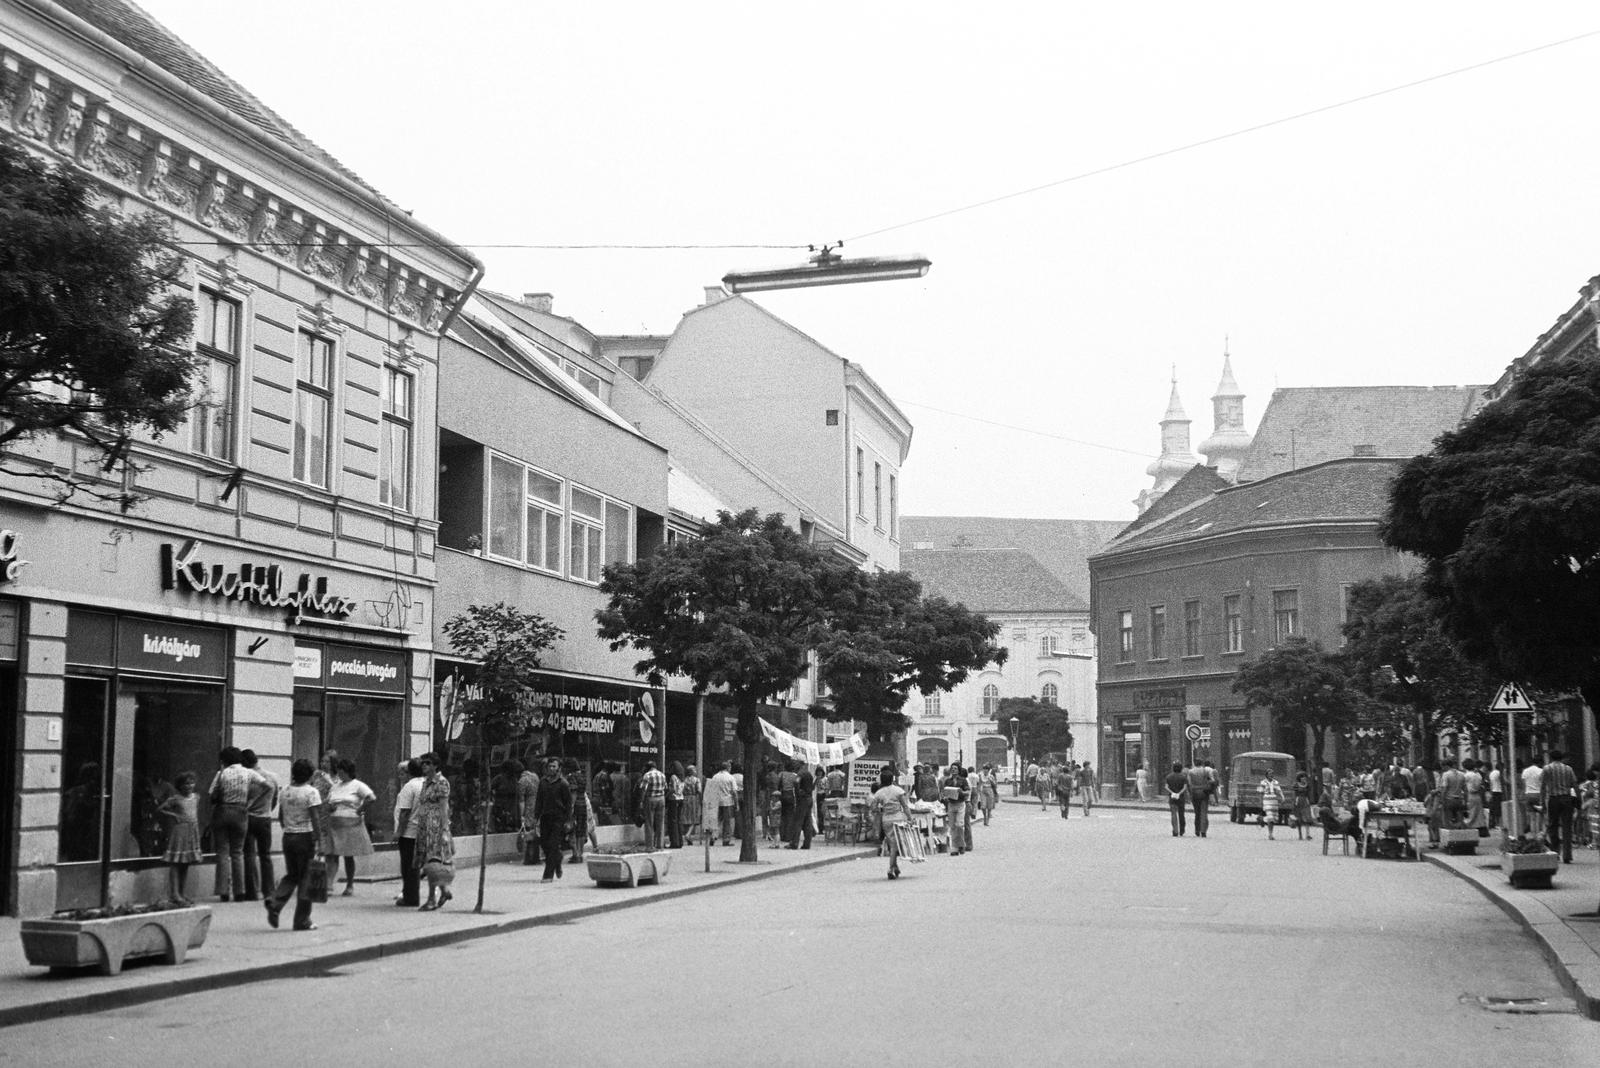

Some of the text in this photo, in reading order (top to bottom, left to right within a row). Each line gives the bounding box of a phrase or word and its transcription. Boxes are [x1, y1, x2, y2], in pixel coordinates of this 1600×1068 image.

[143, 633, 201, 662] kristályáru
[367, 661, 397, 682] üvegáru
[554, 694, 587, 712] TIP-TOP
[587, 697, 611, 715] NYÁRI
[611, 700, 635, 716] CIPŐT
[566, 716, 615, 733] ENGEDMÉNY
